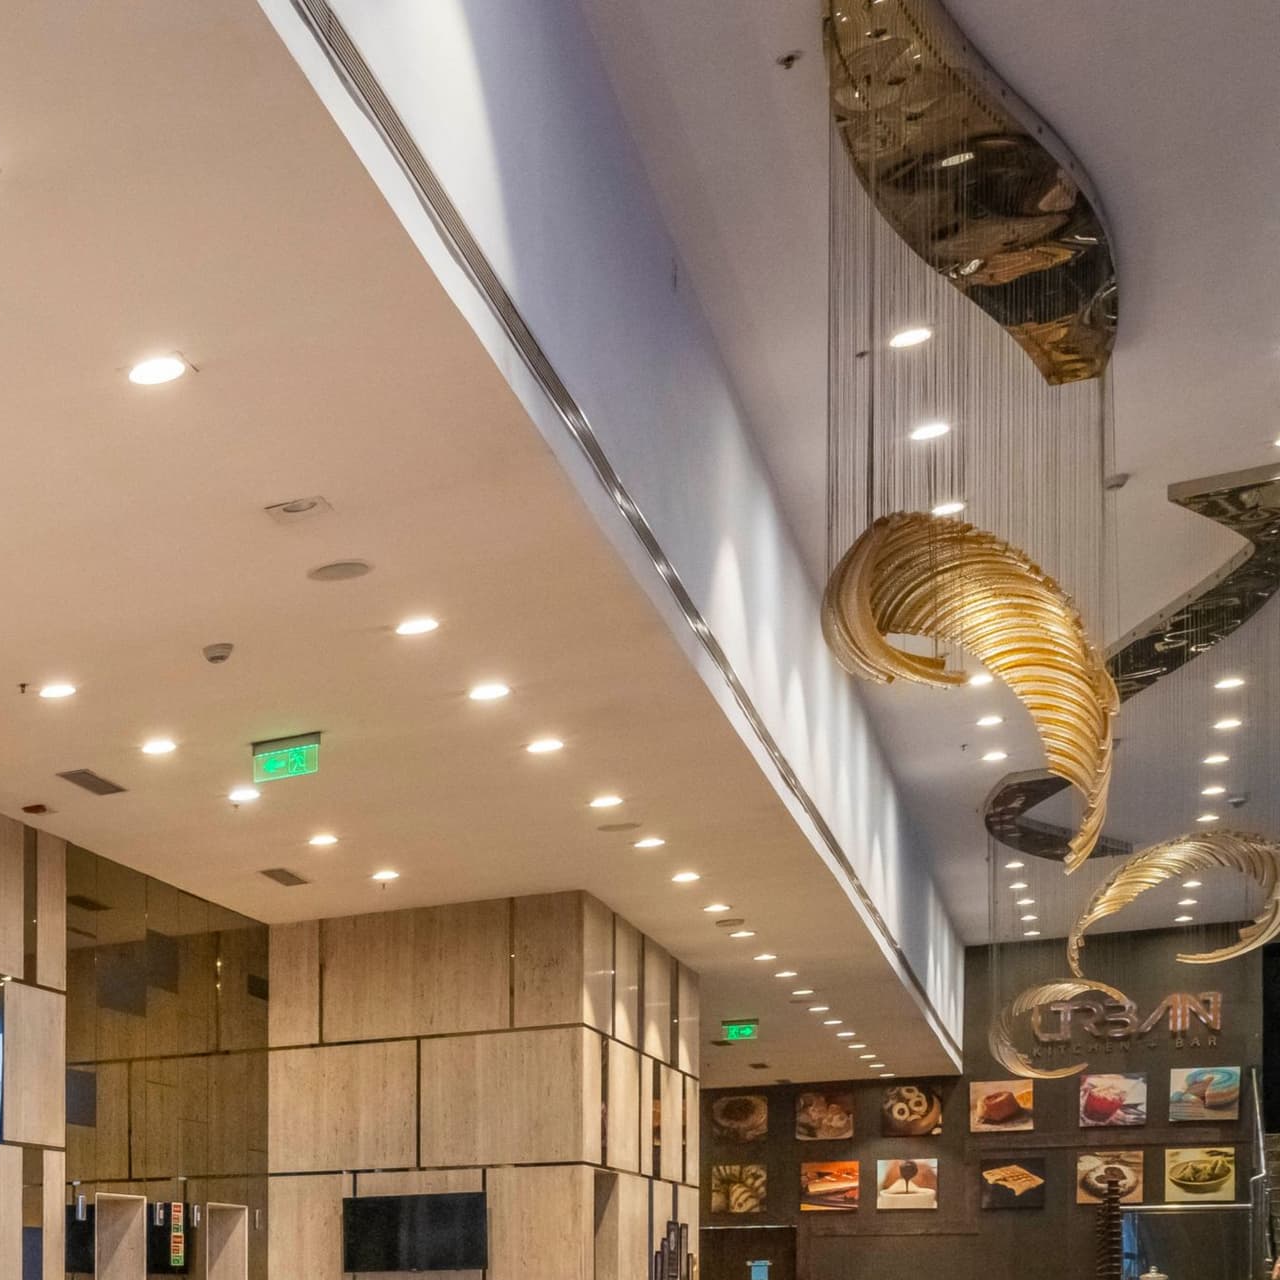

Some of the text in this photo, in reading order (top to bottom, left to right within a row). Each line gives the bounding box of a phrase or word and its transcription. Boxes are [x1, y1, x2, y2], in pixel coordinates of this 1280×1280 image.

[1031, 991, 1223, 1043] URBAN
[1033, 1041, 1131, 1057] KITCHEN
[1175, 1036, 1218, 1049] BAR
